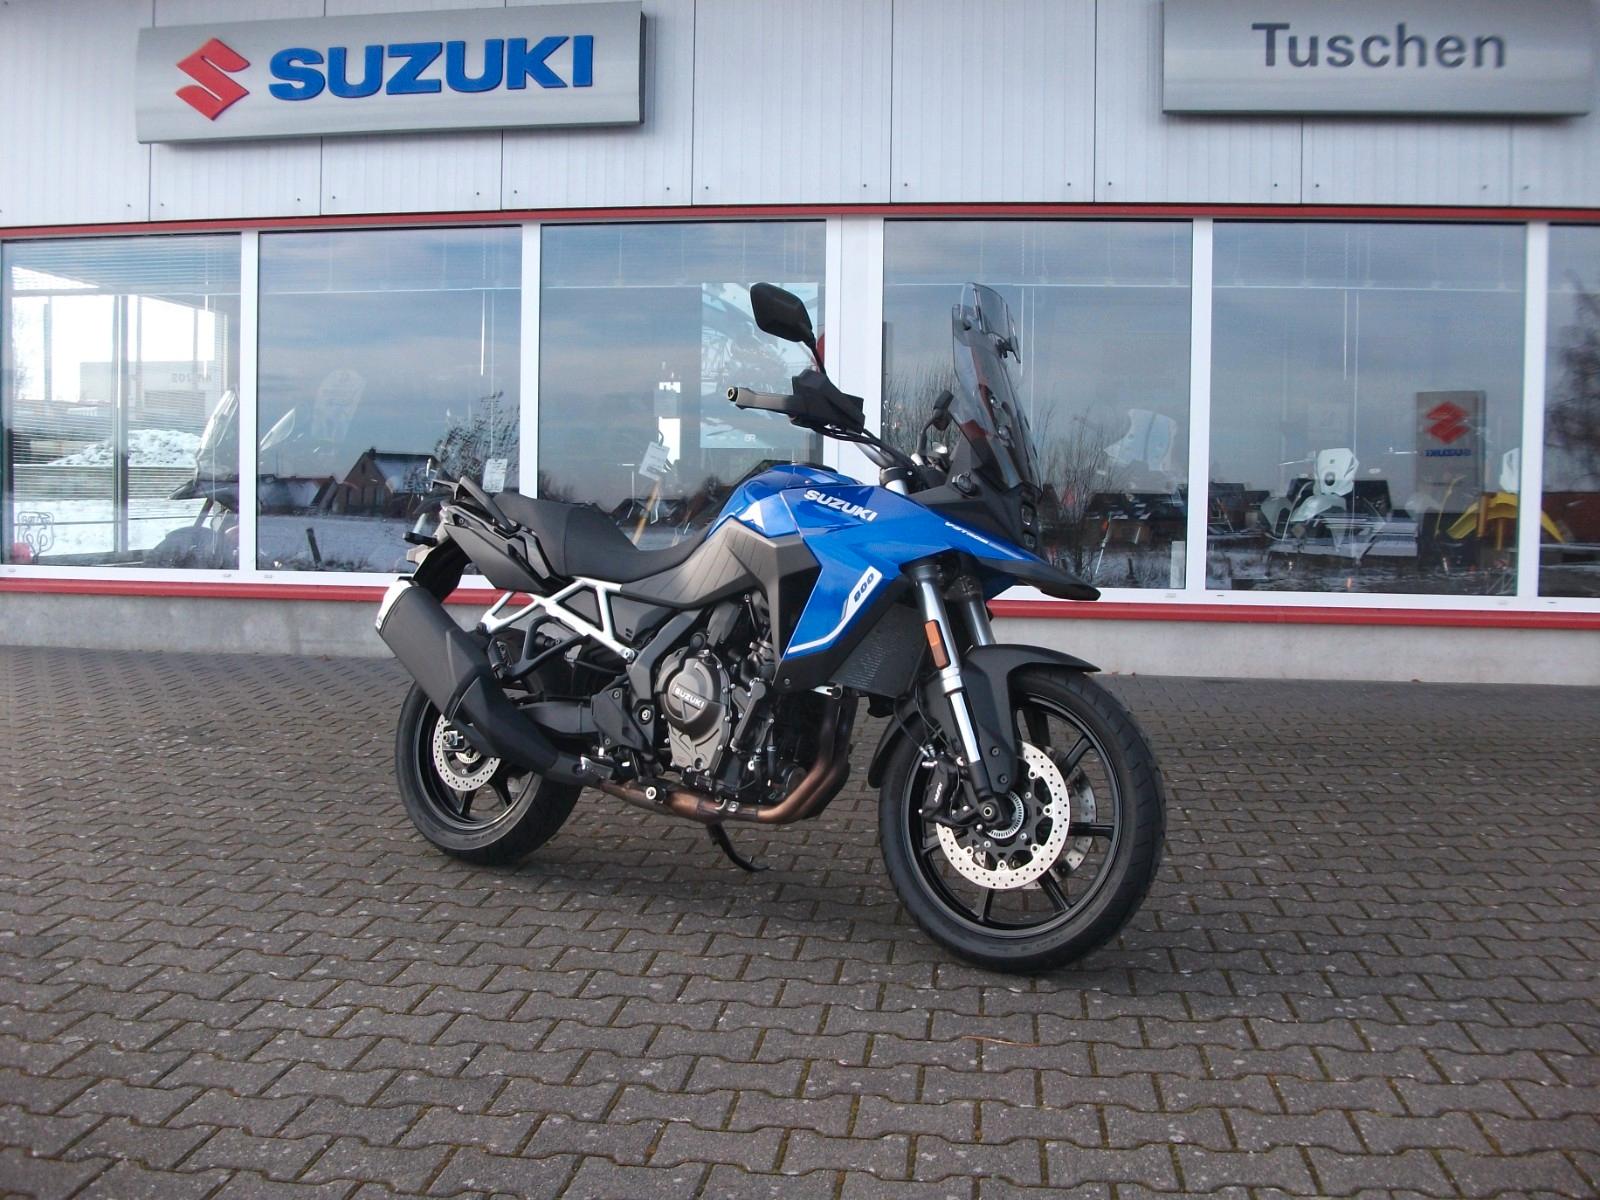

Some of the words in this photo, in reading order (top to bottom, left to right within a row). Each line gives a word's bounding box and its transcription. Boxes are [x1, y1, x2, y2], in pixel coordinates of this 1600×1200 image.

[1251, 22, 1506, 68] Tuschen
[268, 34, 594, 101] SUZUKI
[804, 489, 878, 522] SUZUKI
[674, 686, 705, 709] SUZUKI
